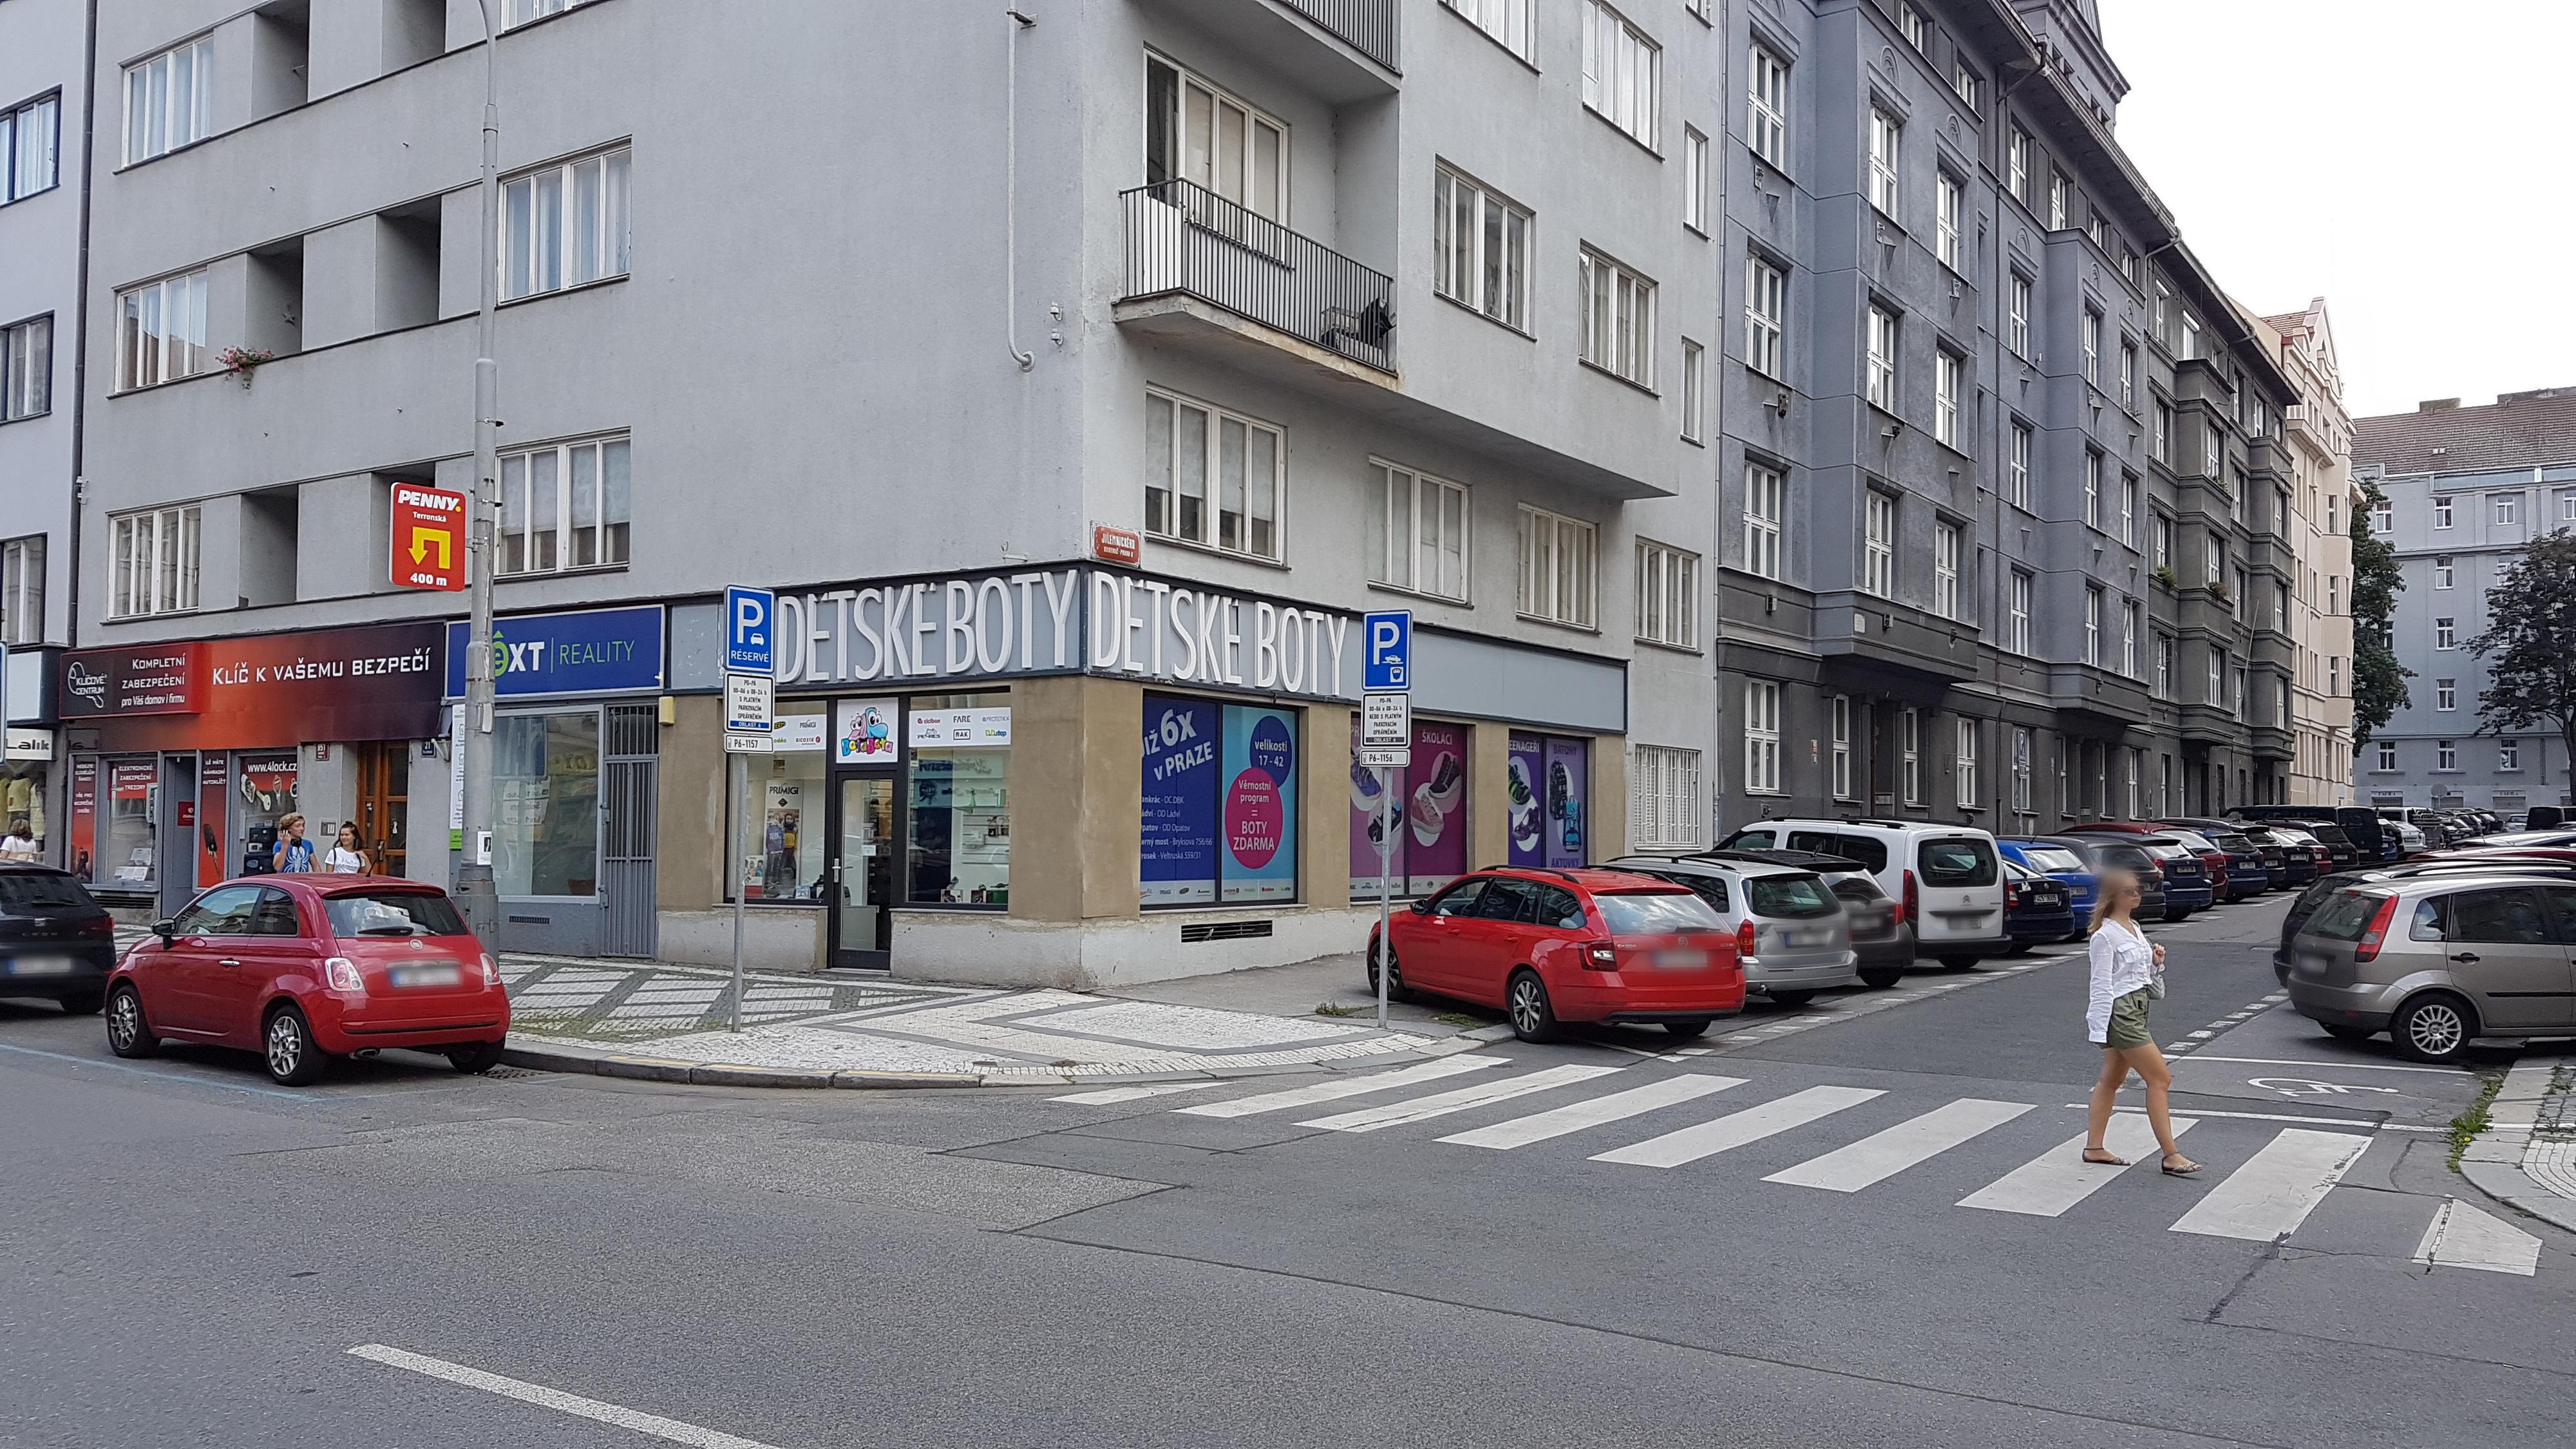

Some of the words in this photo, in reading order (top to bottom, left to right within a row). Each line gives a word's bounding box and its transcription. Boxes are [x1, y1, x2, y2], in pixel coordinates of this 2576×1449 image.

[412, 511, 447, 522] Terronská
[410, 573, 434, 585] 400
[436, 577, 447, 586] m
[737, 597, 764, 644] P
[776, 582, 938, 684] DĚTSKÉ
[946, 569, 1079, 674] BOTY
[1093, 571, 1243, 685] DĚTSKÉ
[1254, 601, 1348, 697] BOTY
[1373, 621, 1400, 665] P
[559, 639, 635, 665] REALITY
[730, 648, 770, 663] RÉSERVÉ
[132, 653, 186, 670] KOMPLETNÍ
[213, 661, 249, 685] KLÍČ
[256, 667, 267, 682] K
[274, 656, 343, 680] VAŠEMU
[352, 647, 431, 676] BEZPEČÍ
[122, 672, 185, 690] ZABEZPEČENÍ
[121, 698, 132, 708] pro
[953, 715, 971, 723] FARE
[734, 739, 759, 748] P6-1157
[1255, 738, 1288, 752] velikosti
[1509, 739, 1540, 753] EENAGEŘI
[1164, 741, 1213, 777] PRAZE
[1258, 755, 1268, 766] 17
[1274, 756, 1284, 767] 42
[1369, 753, 1393, 762] P6-1156
[247, 760, 298, 773] www.4lock.cz
[769, 785, 799, 795] PRIMIGI
[1238, 779, 1272, 791] Věrnostní
[1142, 795, 1160, 804] ankrác
[1240, 794, 1270, 805] program
[1142, 824, 1159, 833] patov
[1241, 820, 1268, 835] BOTY
[1141, 837, 1154, 848] erný
[1233, 837, 1275, 851] ZDARMA
[1141, 851, 1157, 860] rosek
